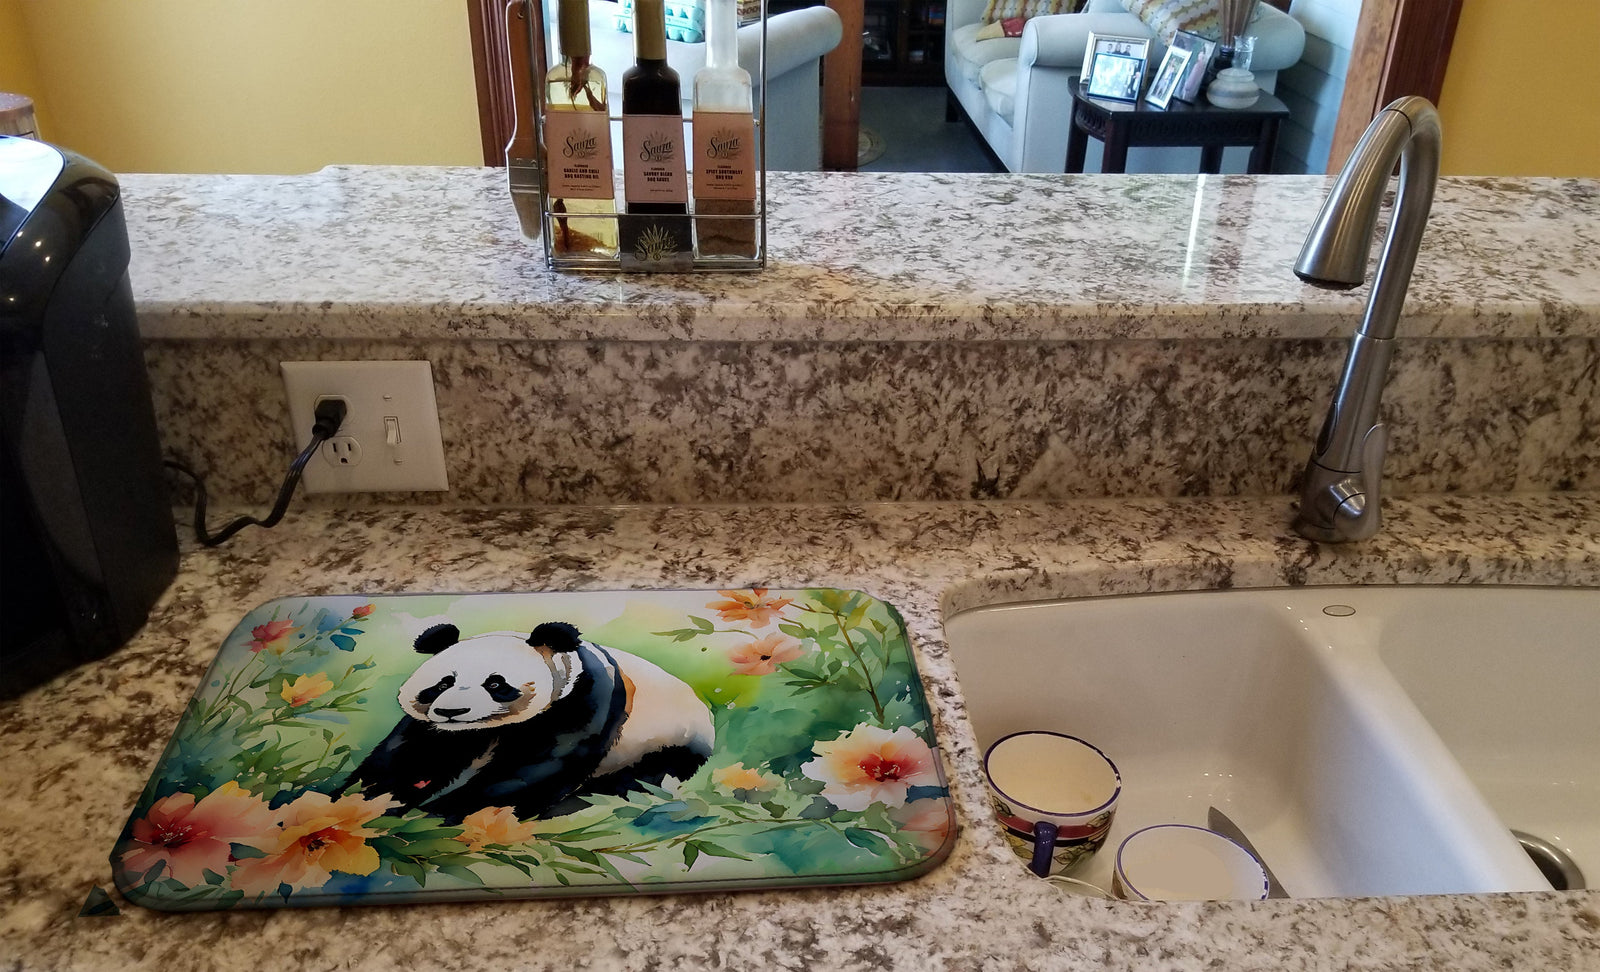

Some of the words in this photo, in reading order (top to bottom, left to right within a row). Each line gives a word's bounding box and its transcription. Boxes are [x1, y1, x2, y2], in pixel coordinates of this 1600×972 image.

[562, 136, 597, 158] Sauza
[640, 140, 673, 161] Sauza
[706, 136, 740, 159] Sauza
